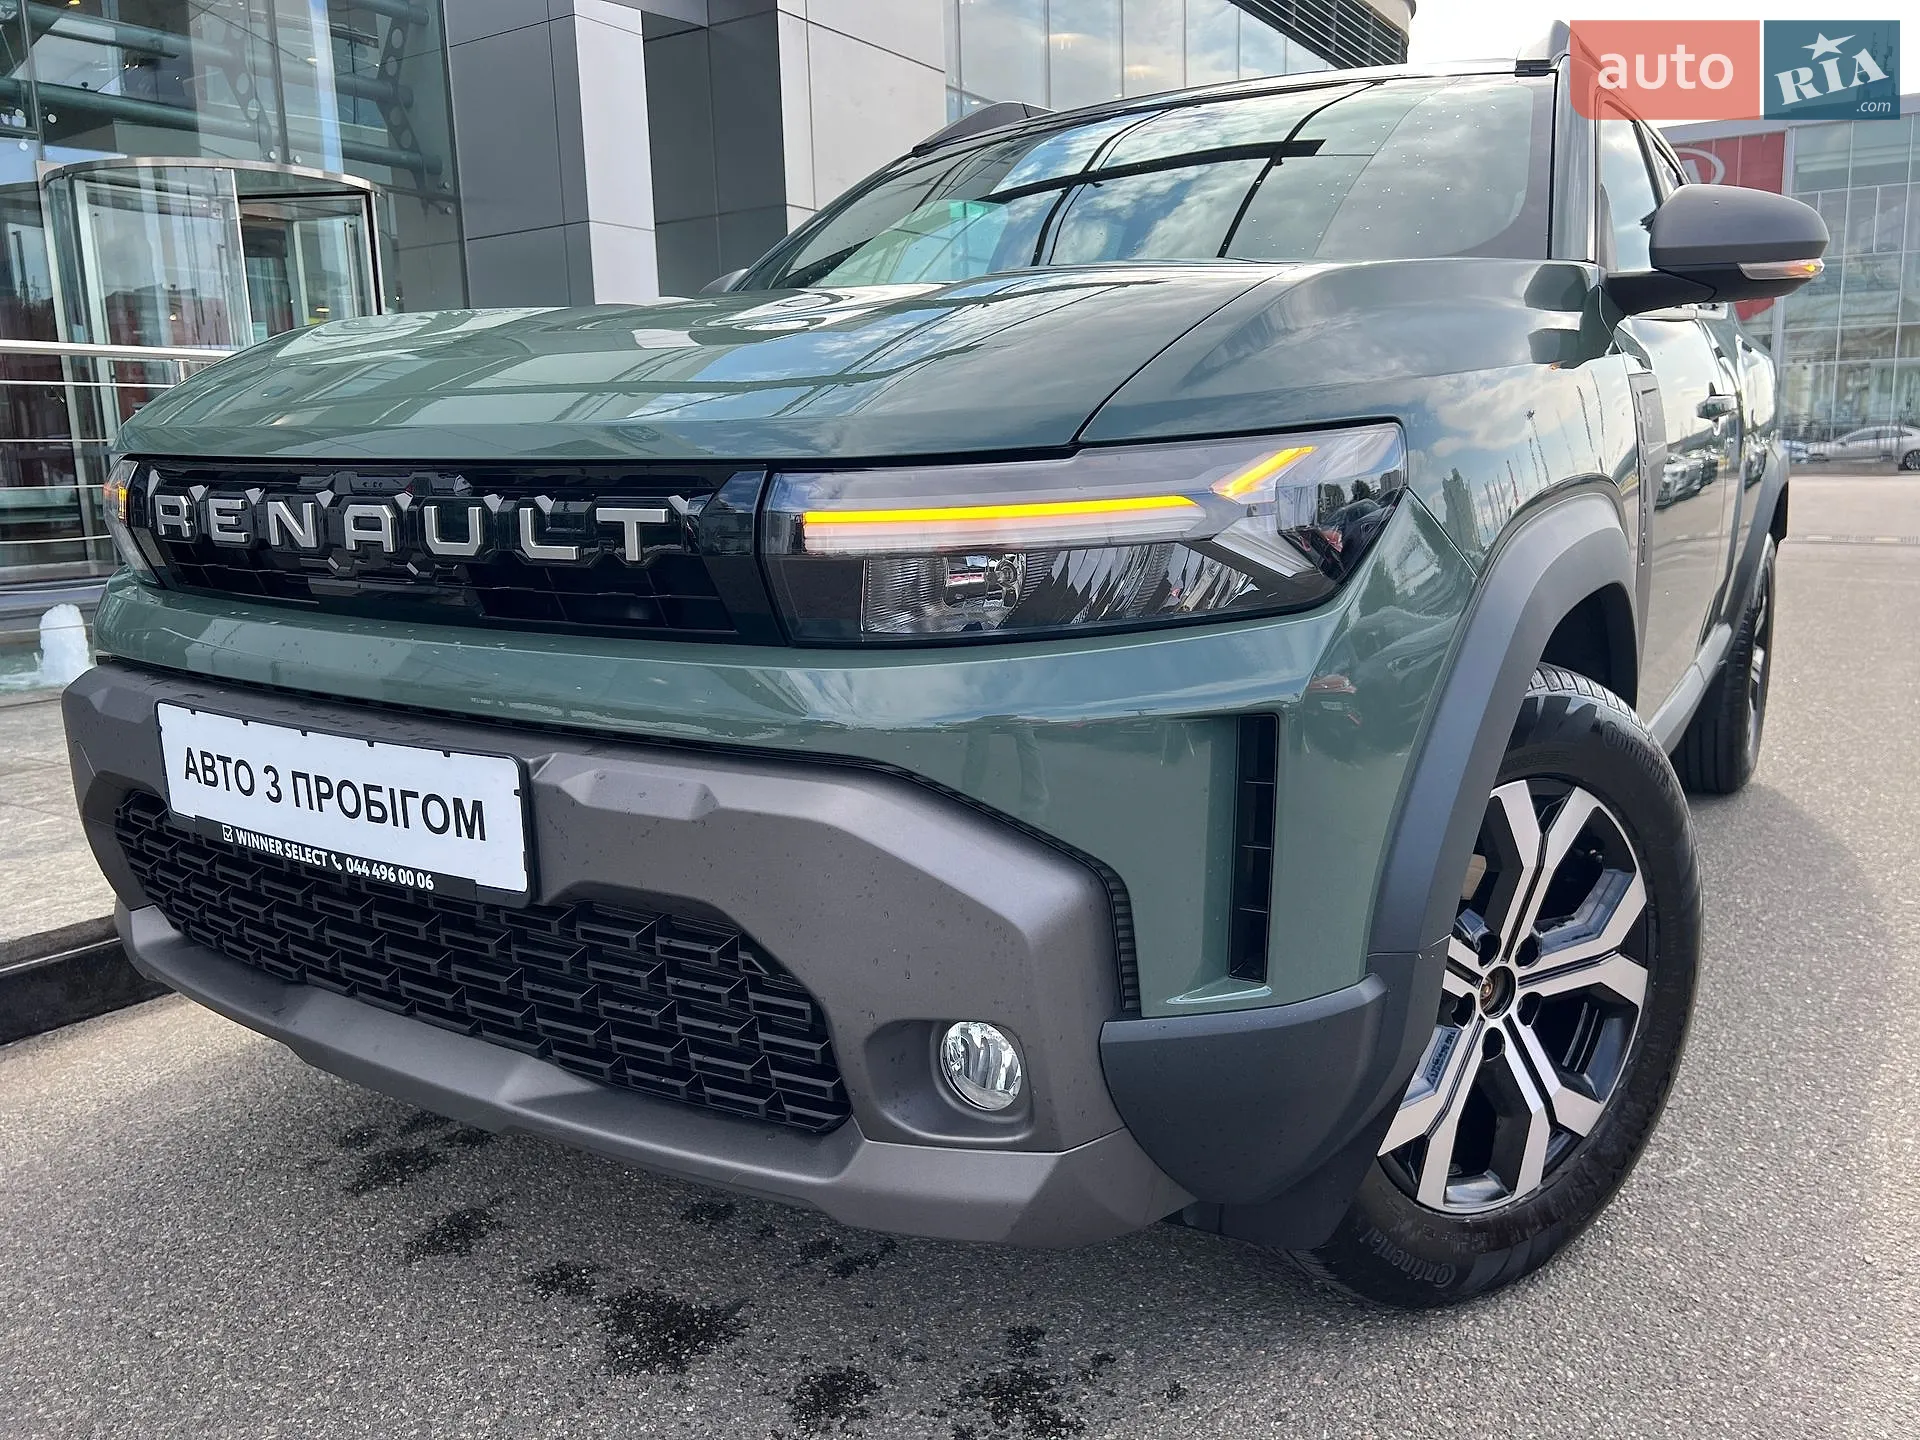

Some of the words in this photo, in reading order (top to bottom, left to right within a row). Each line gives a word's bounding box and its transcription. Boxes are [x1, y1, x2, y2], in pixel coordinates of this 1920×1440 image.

[155, 494, 669, 562] RENAULT
[184, 746, 256, 798] АВТО
[264, 764, 283, 804] З
[291, 770, 487, 842] ПРОБІГОМ
[235, 828, 284, 857] WINNER
[285, 842, 328, 868] SELECT
[345, 857, 370, 878] 044
[371, 861, 397, 884] 496
[398, 866, 415, 888] 00
[416, 869, 435, 892] 06
